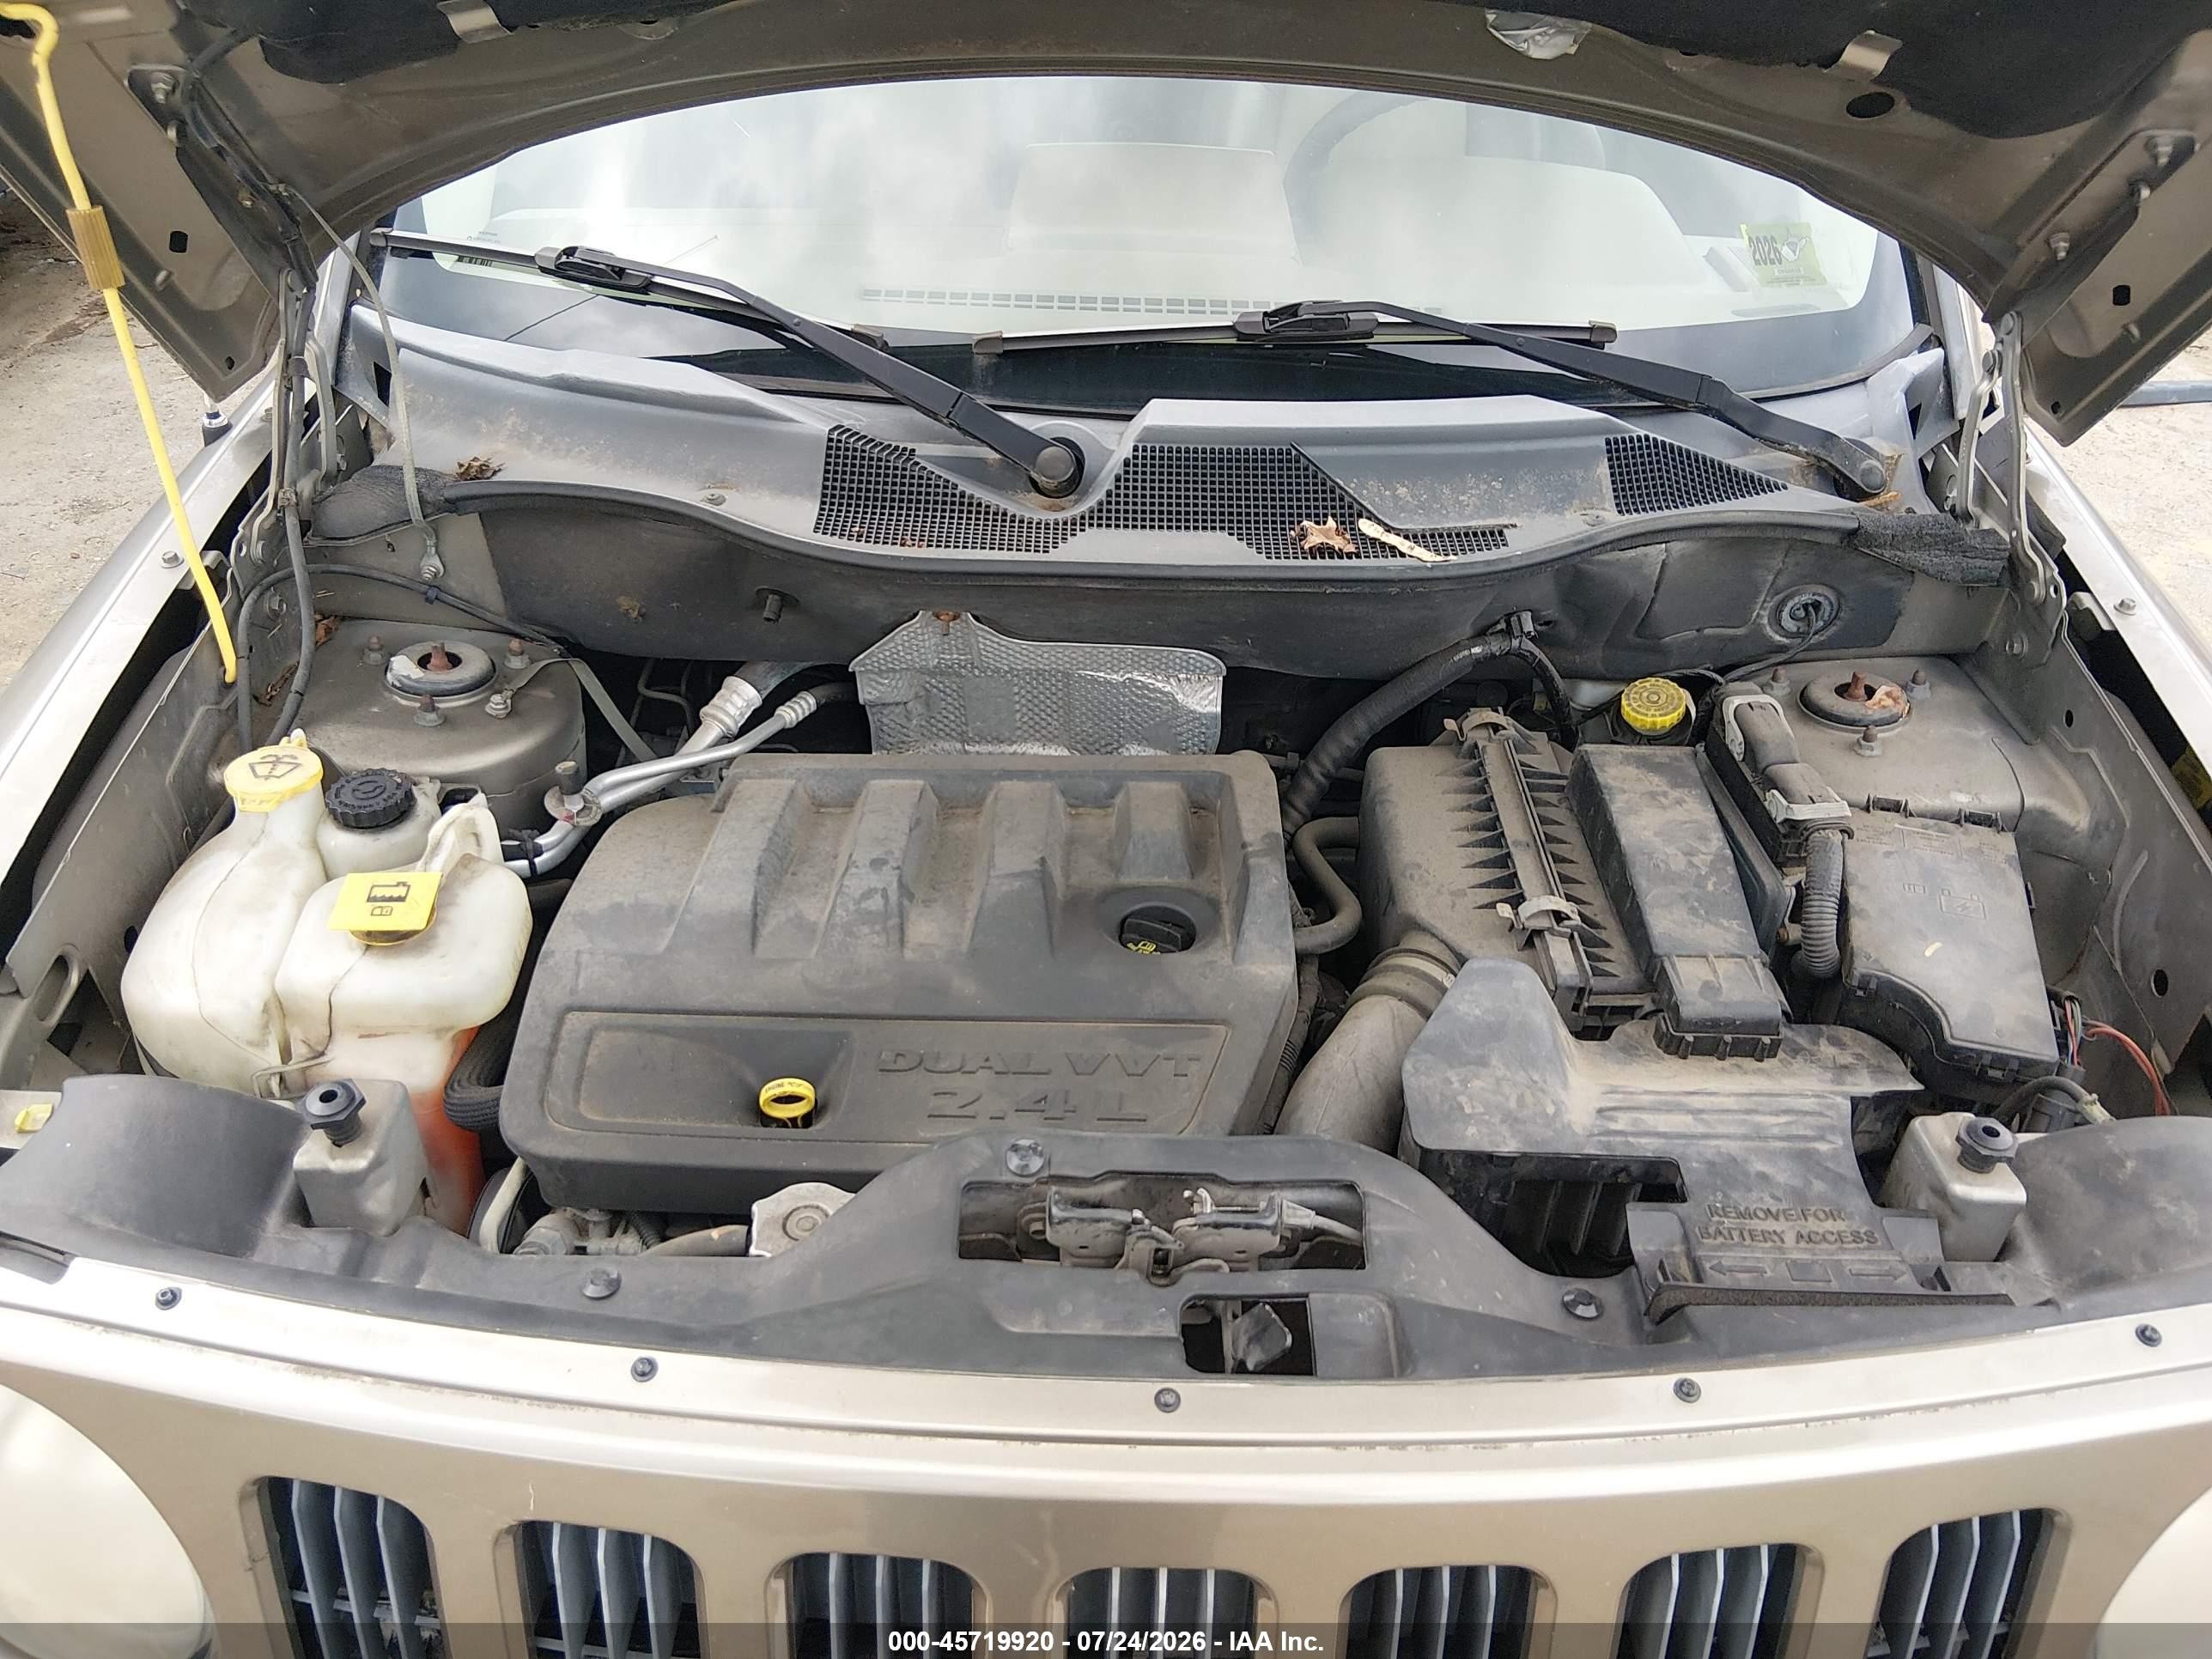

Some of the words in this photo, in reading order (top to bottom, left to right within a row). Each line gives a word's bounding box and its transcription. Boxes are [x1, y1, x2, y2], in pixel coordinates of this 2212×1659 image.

[879, 1050, 1051, 1075] DUAL
[1065, 1052, 1200, 1077] VVT
[1706, 1204, 1801, 1223] REMOVE
[1801, 1207, 1846, 1224] FOR
[1696, 1224, 1786, 1244] BATTERY
[1795, 1229, 1881, 1245] ACCESS
